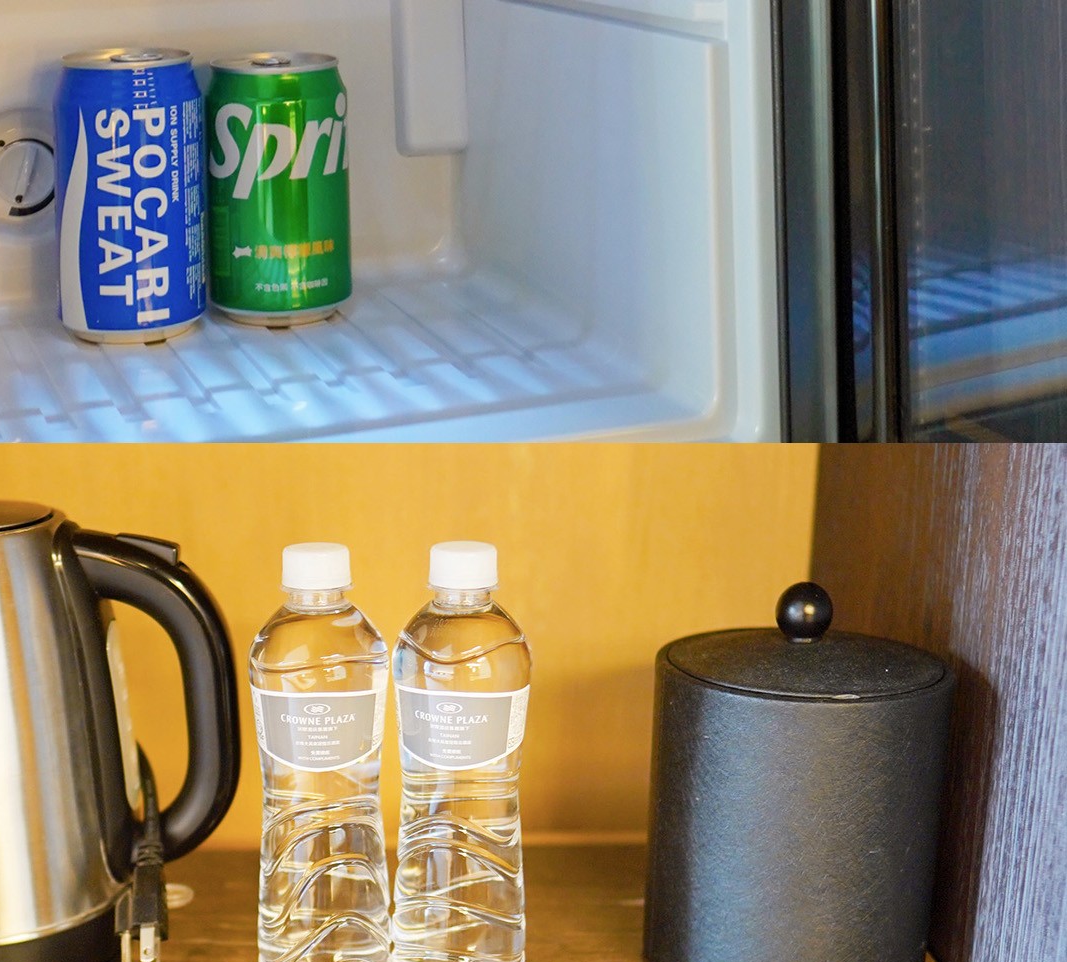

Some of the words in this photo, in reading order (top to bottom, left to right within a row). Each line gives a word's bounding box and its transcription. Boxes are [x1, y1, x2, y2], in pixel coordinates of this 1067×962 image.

[169, 105, 178, 125] ION
[170, 128, 179, 167] SUPPLY
[171, 170, 180, 202] DRINK
[95, 109, 135, 306] SWEAT
[132, 107, 171, 325] POCARI
[280, 713, 321, 726] CROWNE
[324, 713, 356, 725] PLAZA
[414, 709, 453, 725] CROWNE
[456, 714, 489, 725] PLAZA
